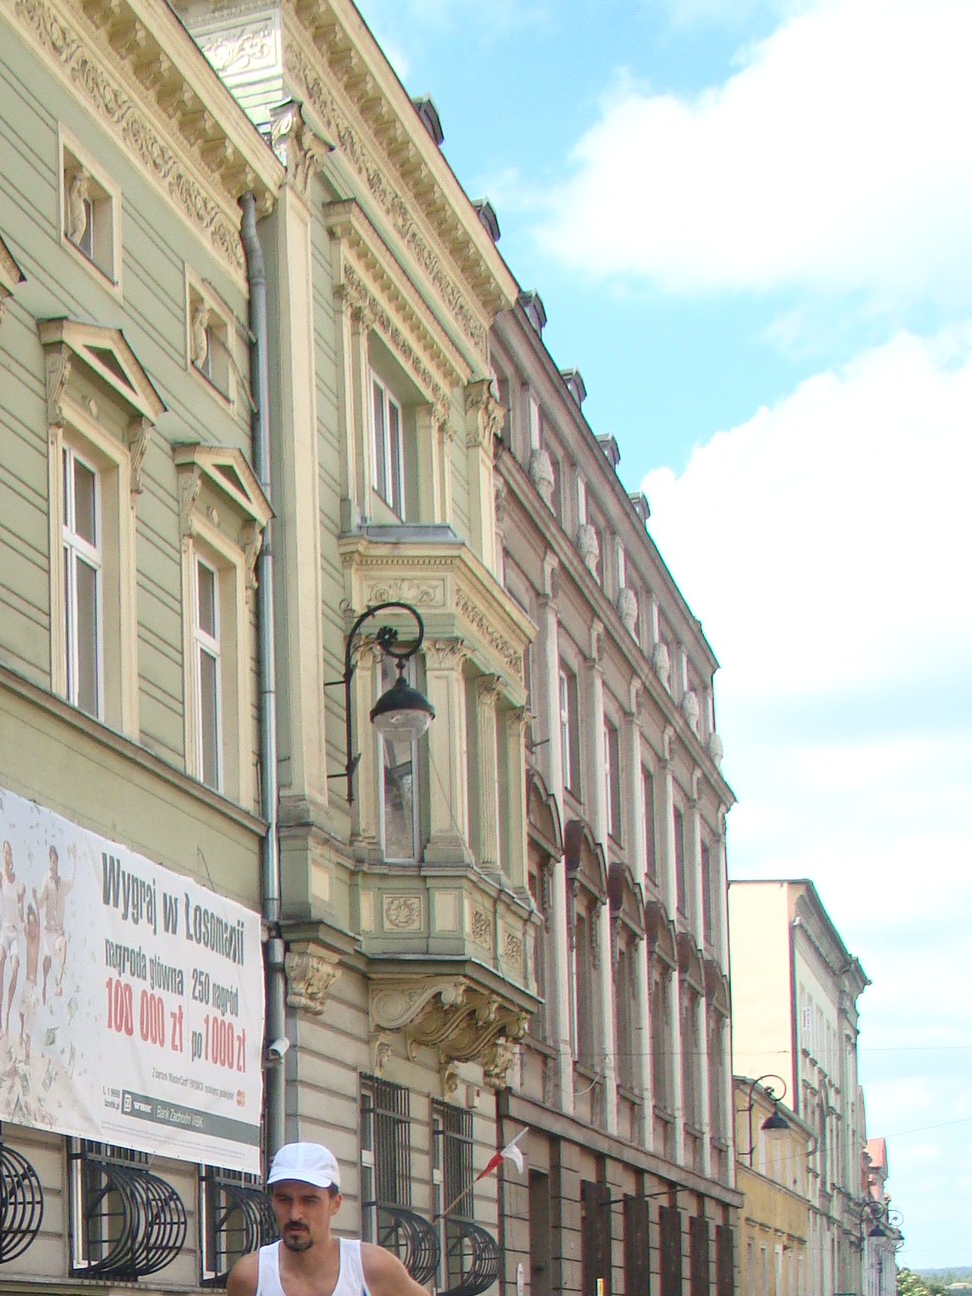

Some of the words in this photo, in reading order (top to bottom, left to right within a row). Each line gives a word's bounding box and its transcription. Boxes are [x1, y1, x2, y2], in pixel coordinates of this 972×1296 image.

[102, 851, 157, 936] Wygraj
[163, 892, 178, 935] w
[105, 938, 147, 982] nagroda
[149, 953, 184, 997] główna
[192, 968, 210, 1006] 250
[212, 984, 239, 1018] nagród
[140, 989, 165, 1048] 000
[170, 1005, 183, 1053] zł
[191, 1030, 203, 1063] po
[236, 1027, 246, 1074] zł
